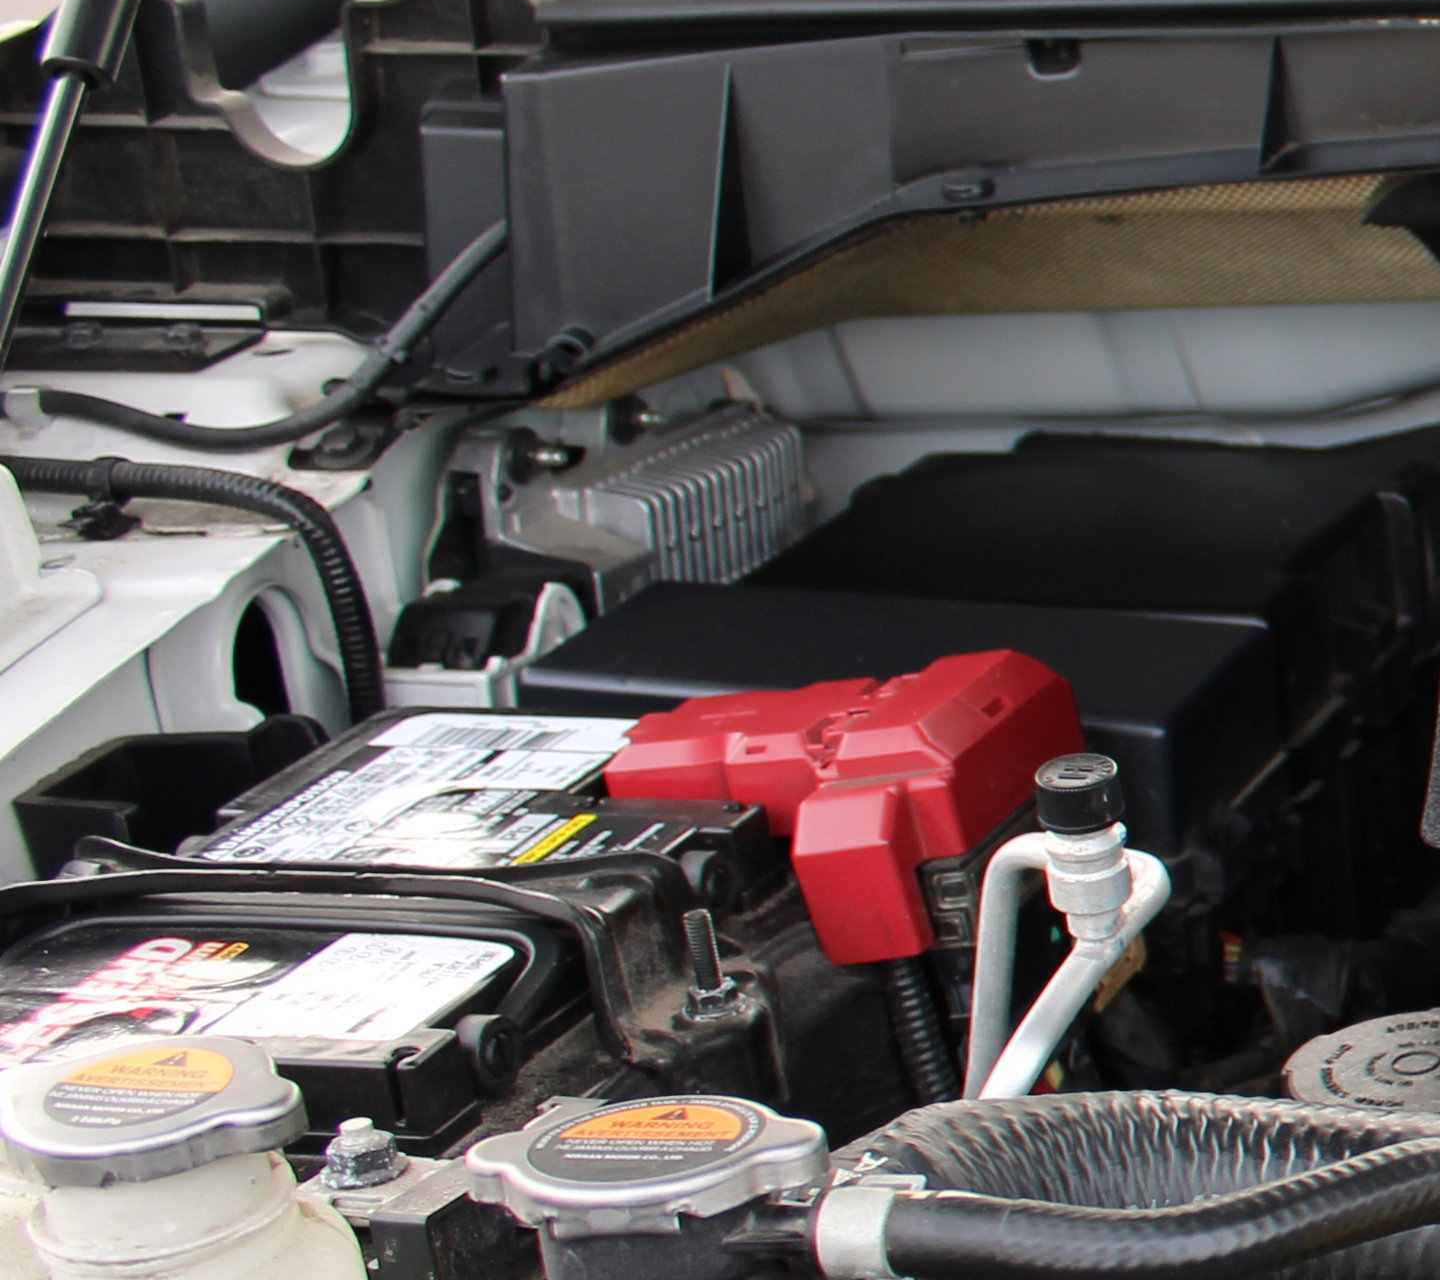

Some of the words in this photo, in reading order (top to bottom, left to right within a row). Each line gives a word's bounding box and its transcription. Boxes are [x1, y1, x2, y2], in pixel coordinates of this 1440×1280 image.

[111, 1064, 208, 1079] WARNING
[73, 1073, 222, 1091] AVERTISSEMENT
[61, 1084, 102, 1095] NEVER
[609, 1120, 715, 1130] WARNING
[572, 1129, 730, 1139] AVERTISSEMENT
[565, 1138, 608, 1146] NEVER
[609, 1138, 645, 1146] OPEN
[648, 1139, 687, 1147] WHEN
